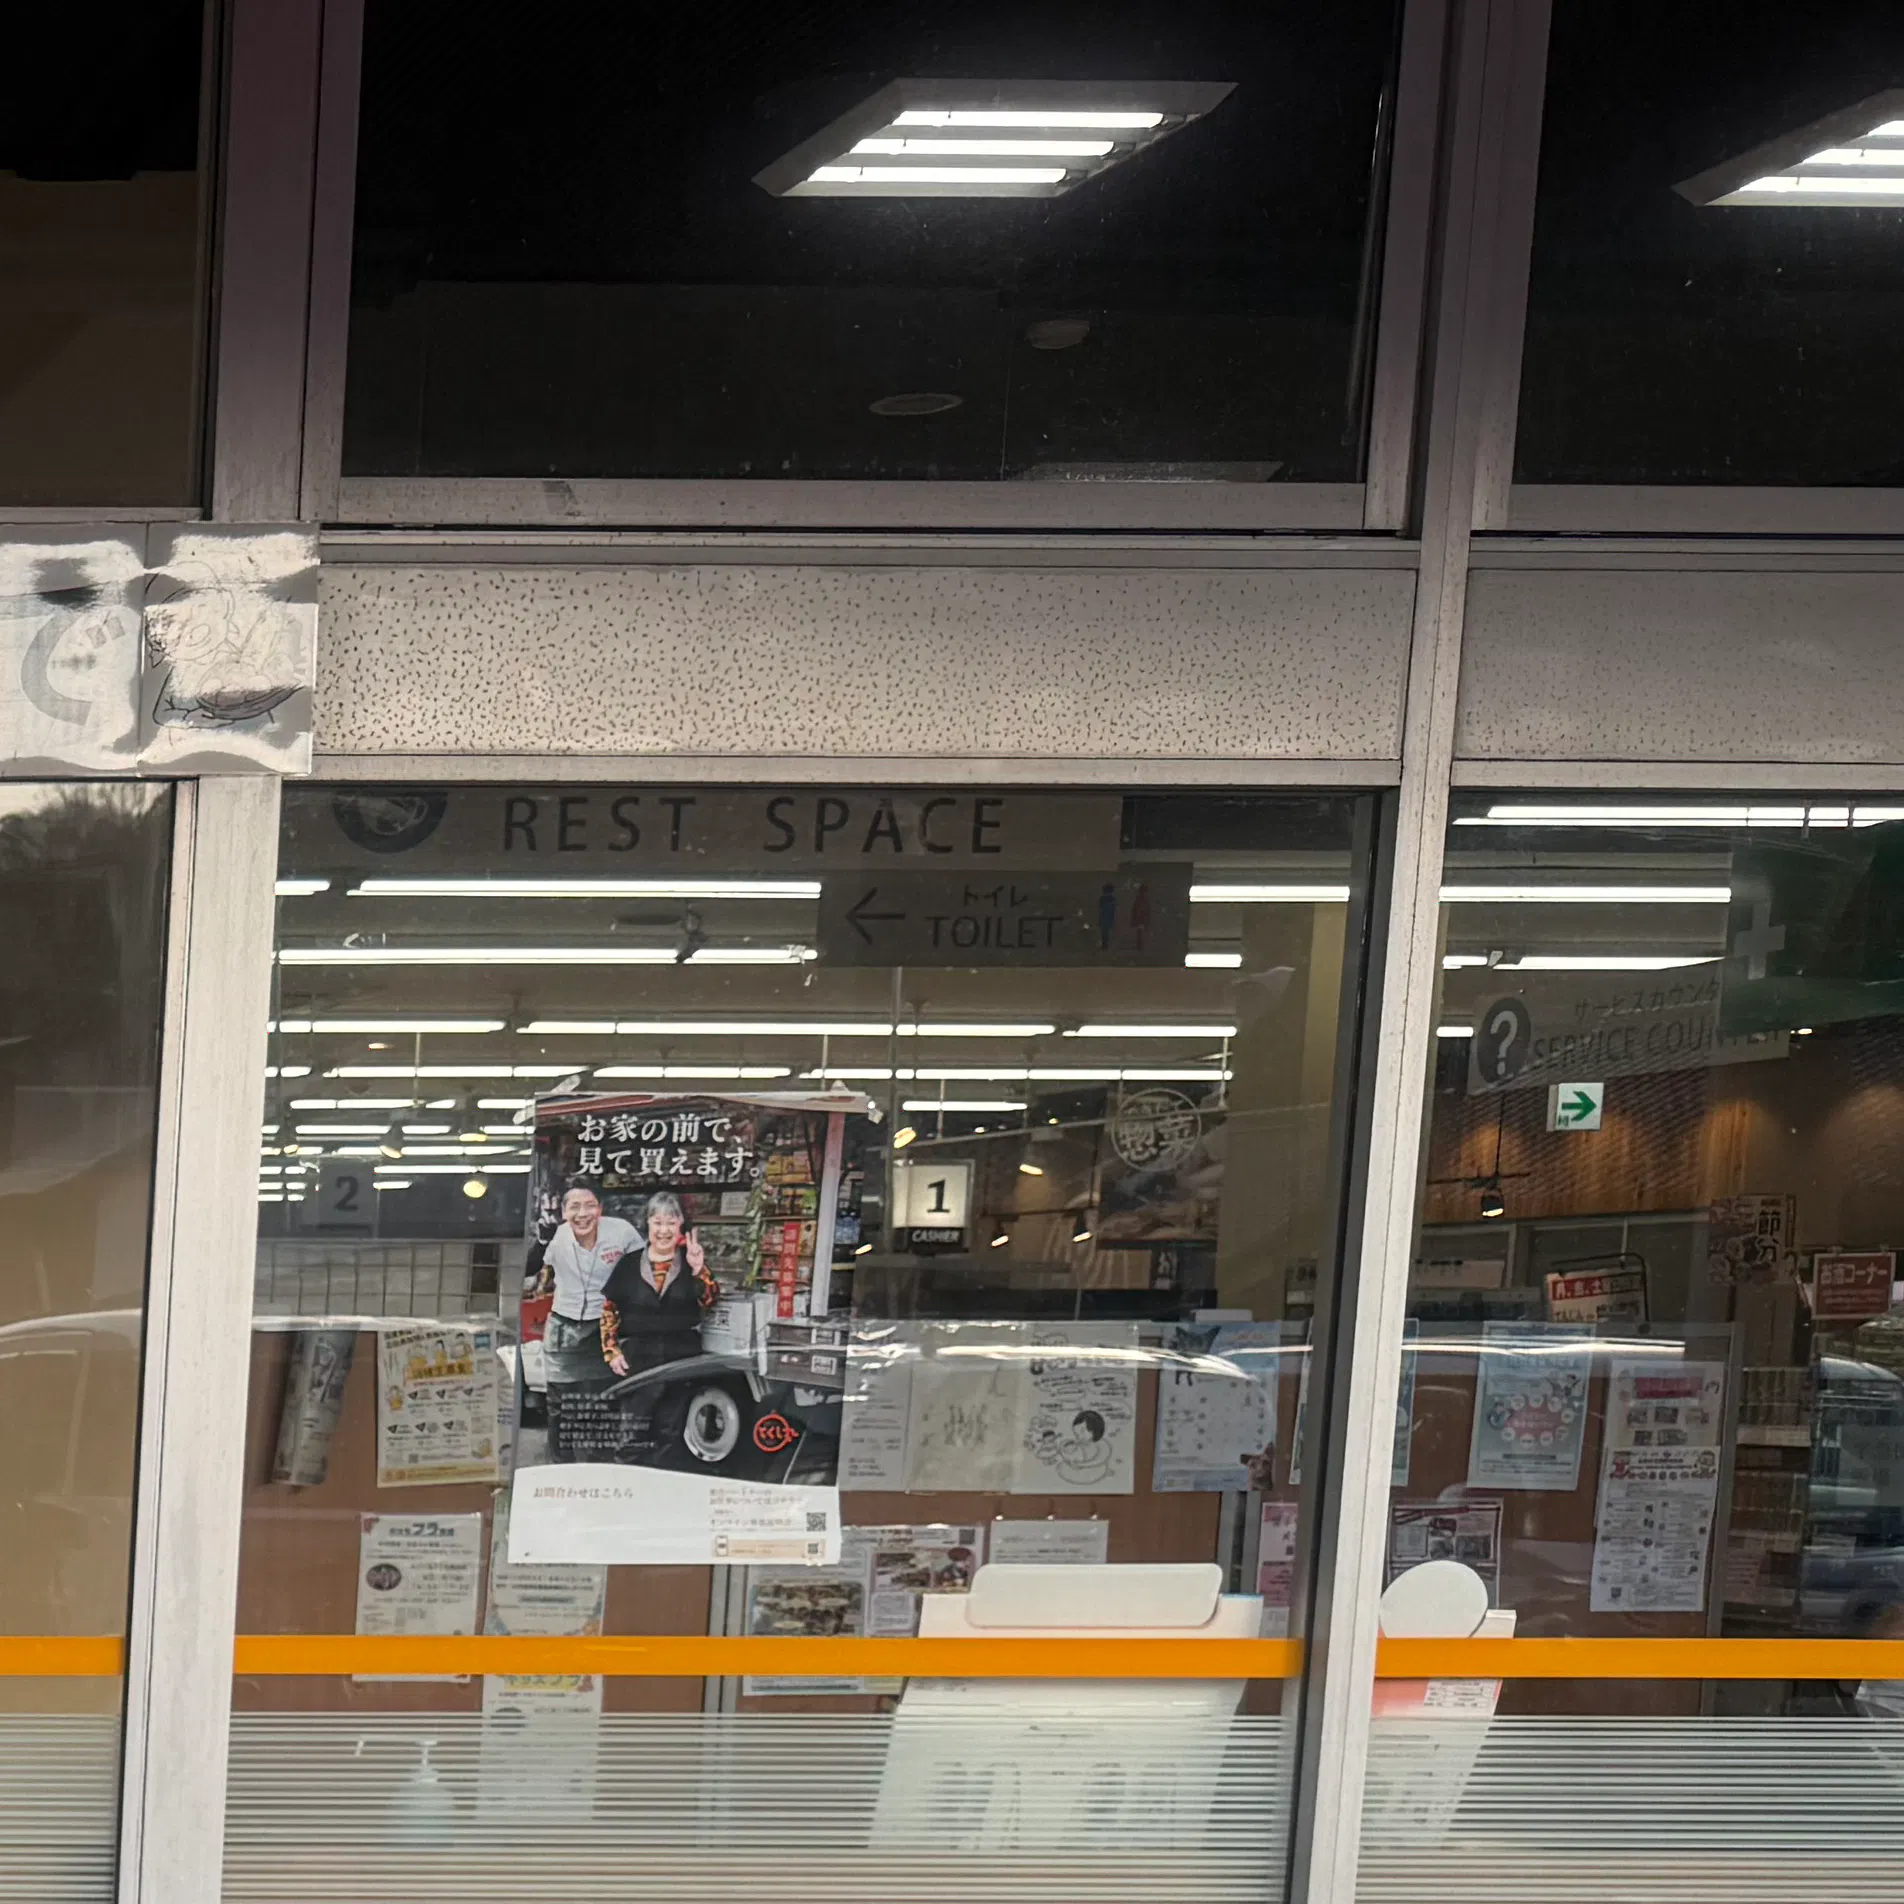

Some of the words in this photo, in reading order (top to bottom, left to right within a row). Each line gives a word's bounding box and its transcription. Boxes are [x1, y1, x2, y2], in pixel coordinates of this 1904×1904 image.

[502, 796, 696, 852] REST
[765, 797, 1003, 855] SPACE
[963, 884, 1028, 905] トイレ
[925, 914, 1063, 952] TOILET
[336, 1176, 359, 1212] 2
[926, 1179, 950, 1214] 1
[911, 1230, 959, 1243] CASHIER
